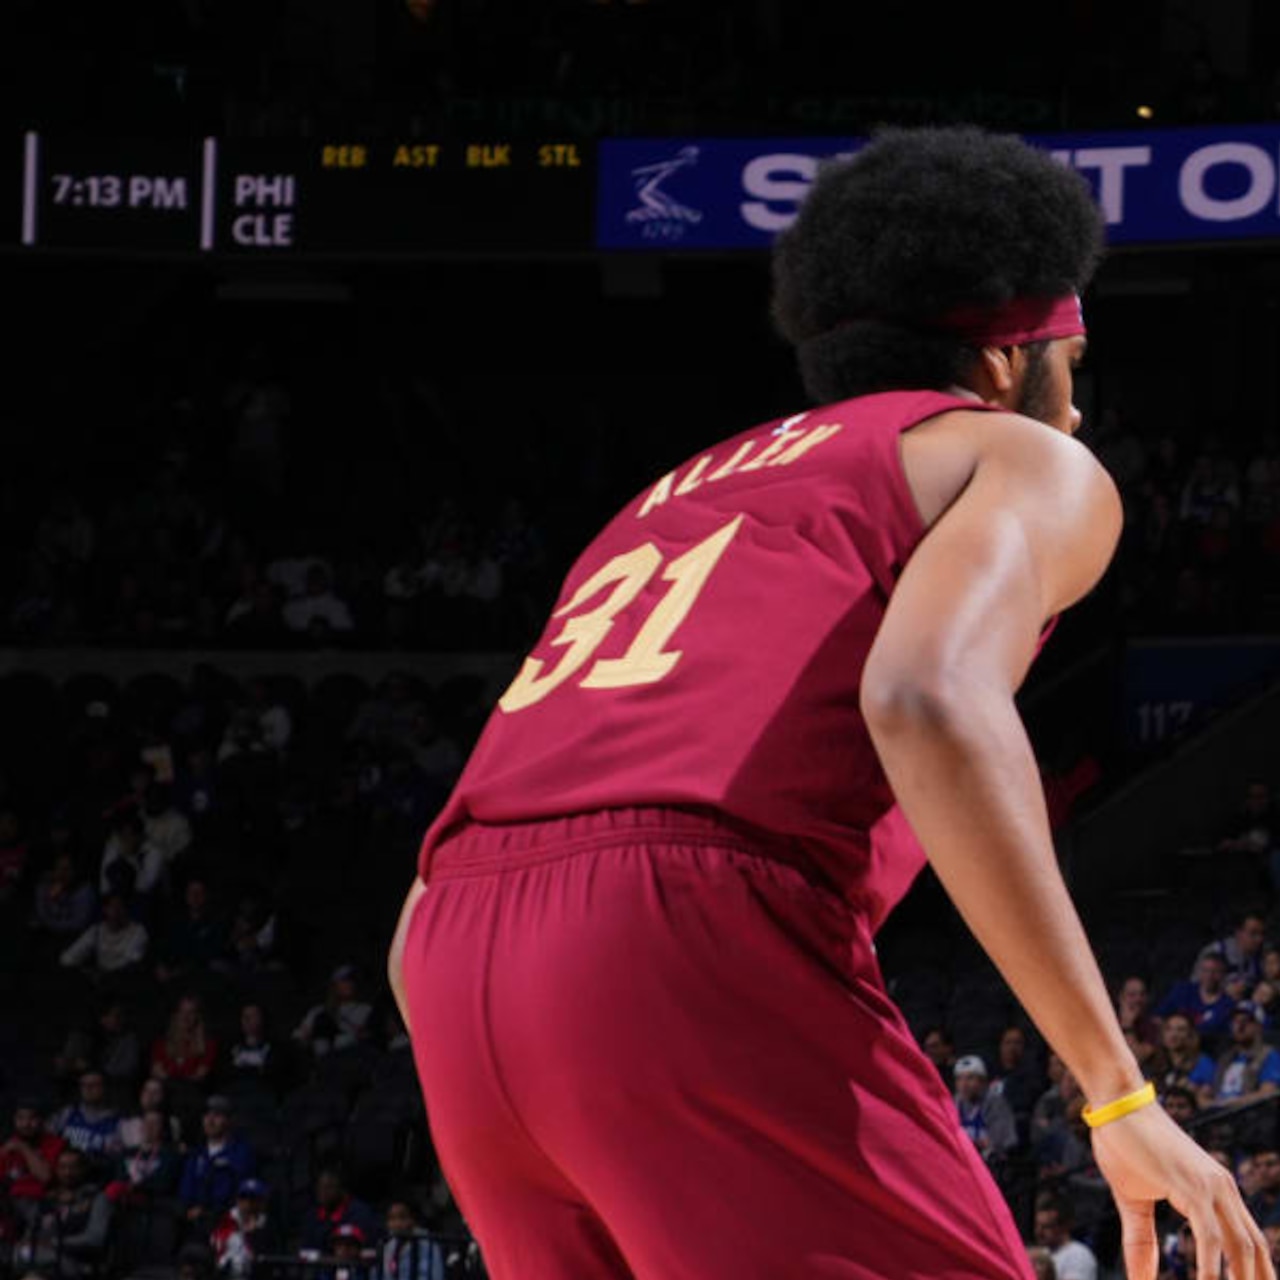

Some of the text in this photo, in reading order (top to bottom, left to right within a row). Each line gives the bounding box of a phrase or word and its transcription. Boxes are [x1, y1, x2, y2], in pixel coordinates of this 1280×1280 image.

[321, 144, 581, 168] REB AST BLK STL
[52, 174, 187, 210] 7:13 PM
[235, 174, 295, 207] PHI
[232, 214, 292, 247] CLE
[498, 510, 747, 714] 31
